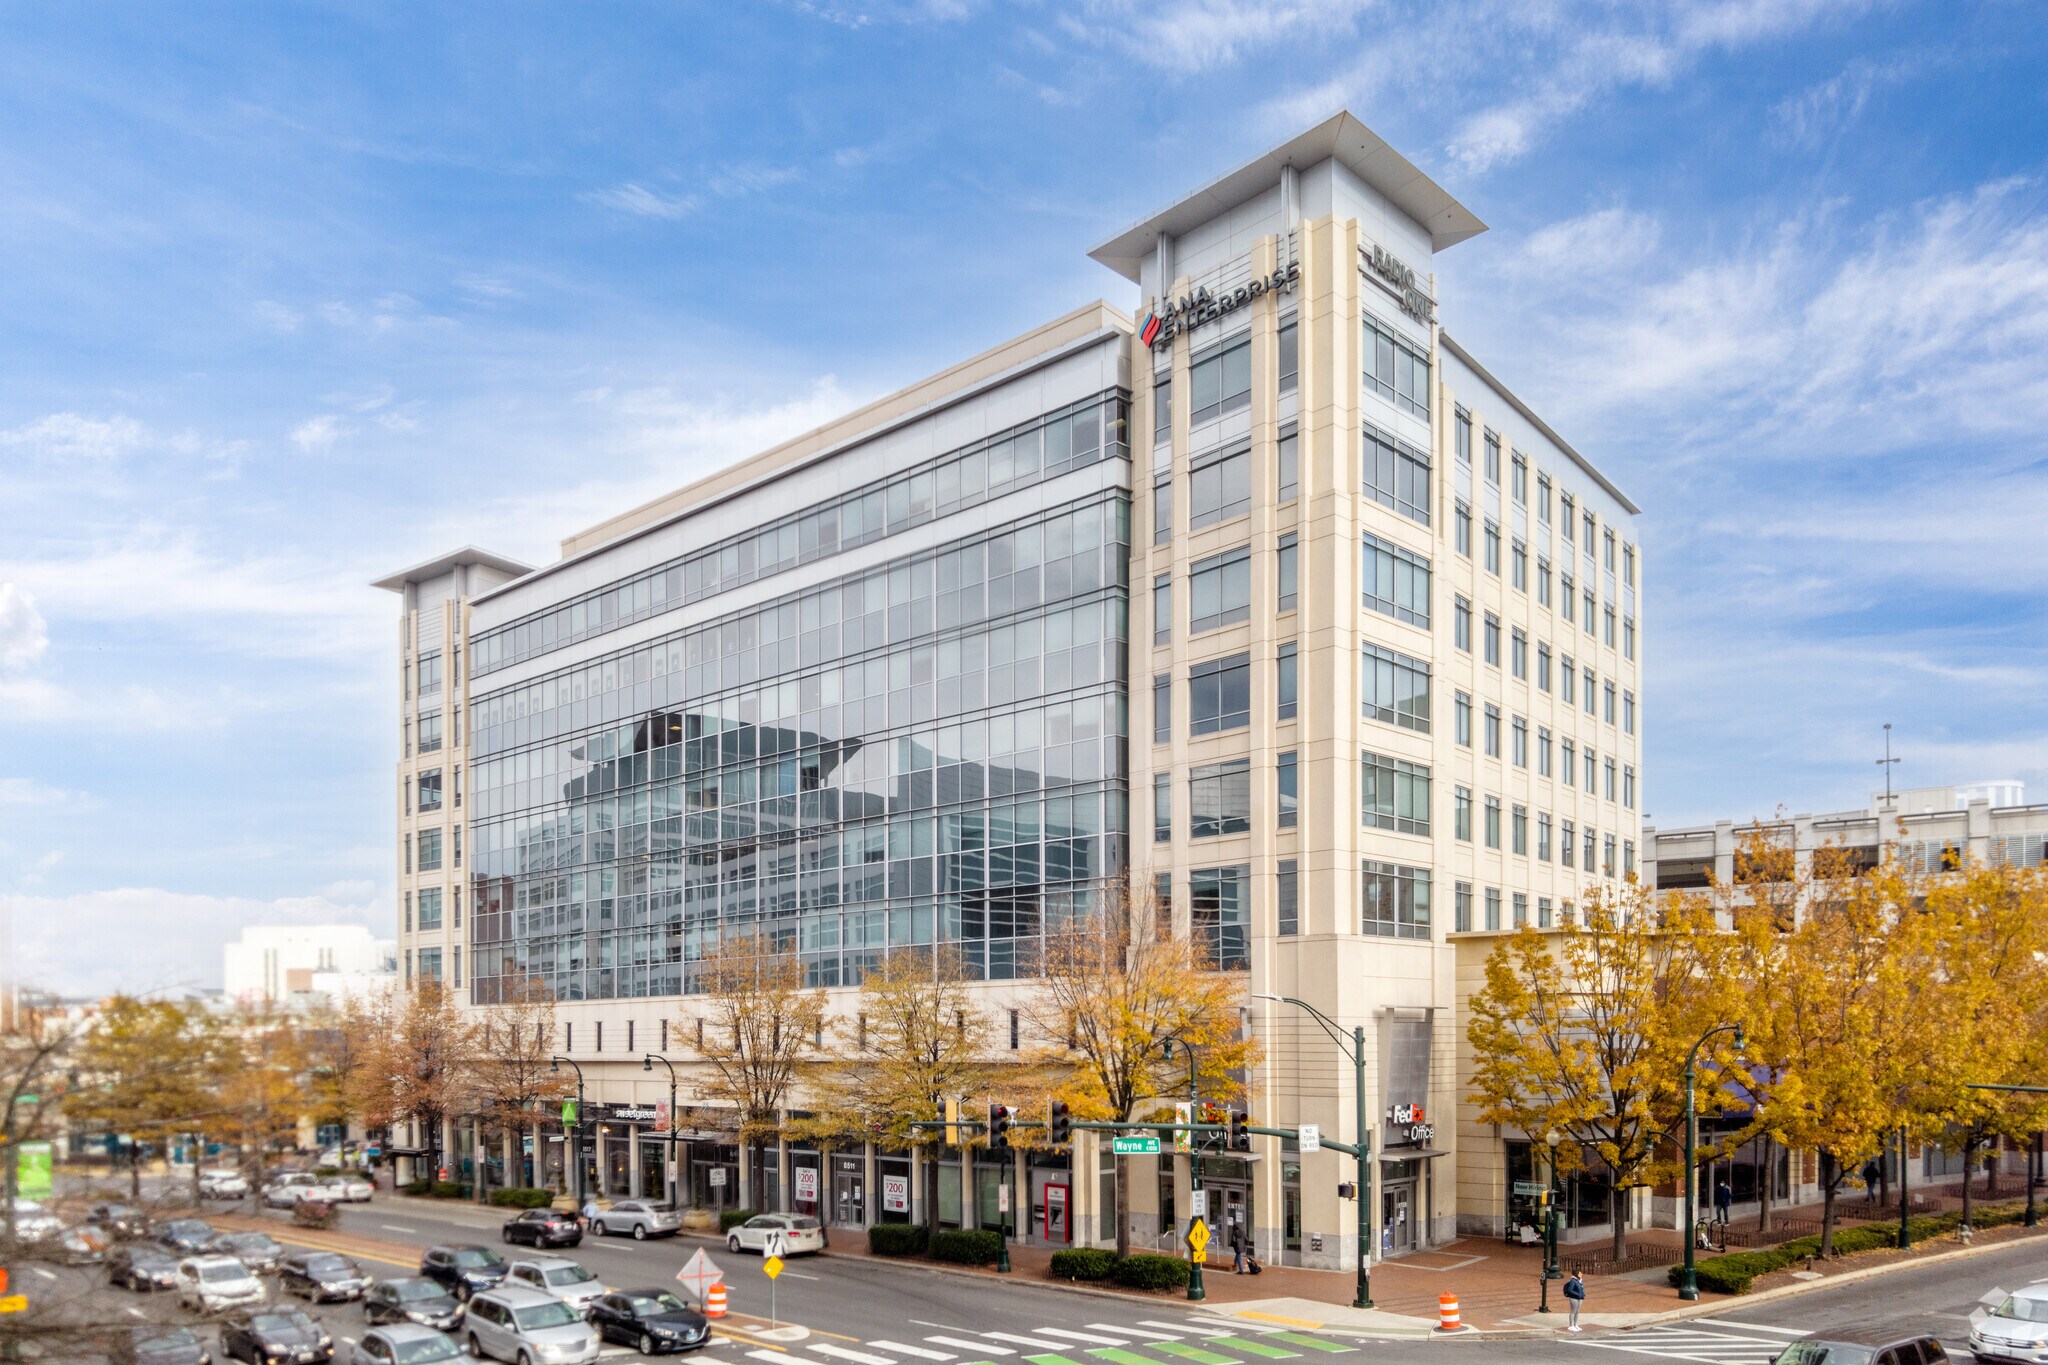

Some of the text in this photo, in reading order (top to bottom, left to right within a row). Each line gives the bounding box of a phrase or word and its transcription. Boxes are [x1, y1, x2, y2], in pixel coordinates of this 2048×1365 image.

[1374, 244, 1415, 289] RADIO
[1163, 260, 1300, 339] ENTERPRISE
[1164, 285, 1210, 320] ANA
[1405, 288, 1433, 321] ONE
[1394, 1103, 1425, 1123] FedEx
[1411, 1125, 1434, 1140] Office
[1116, 1141, 1142, 1152] Wayne
[886, 1182, 903, 1193] $200
